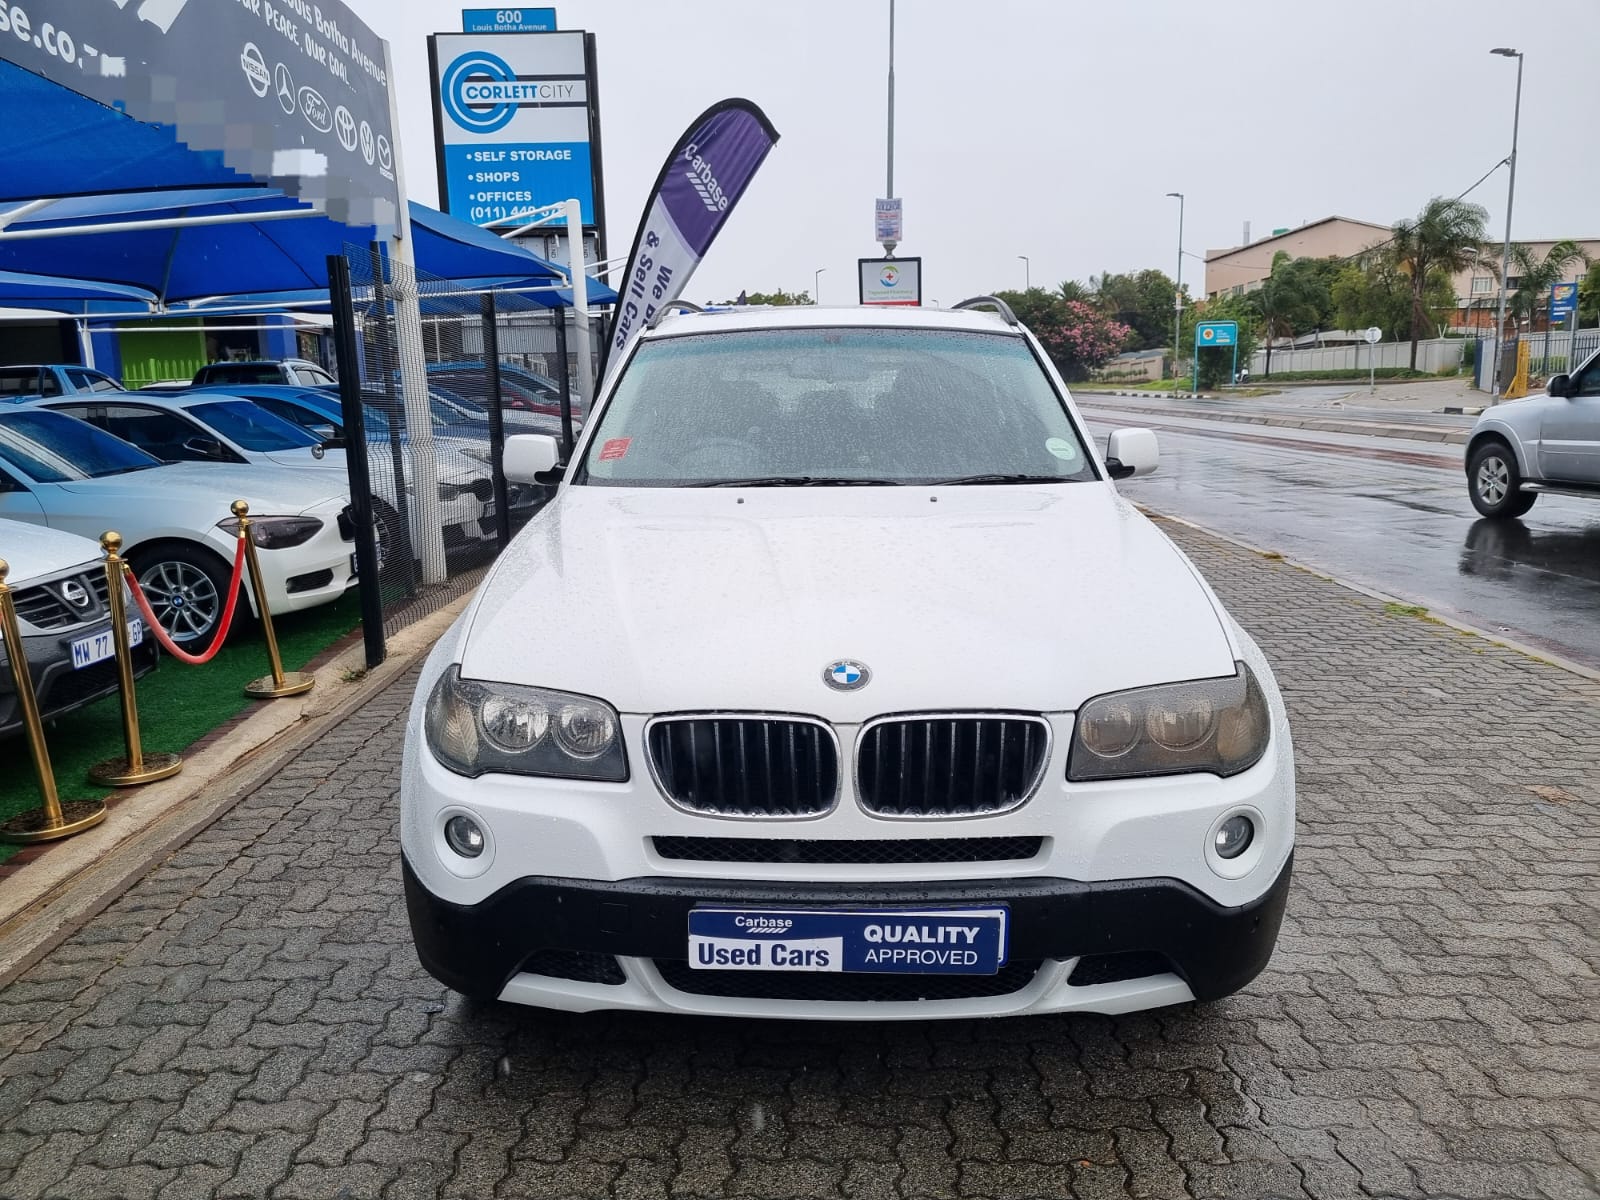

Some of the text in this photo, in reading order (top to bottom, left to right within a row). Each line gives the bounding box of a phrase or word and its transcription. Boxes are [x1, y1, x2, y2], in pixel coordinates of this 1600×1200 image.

[496, 10, 522, 24] 600
[472, 23, 547, 32] Louis Botha Avenue
[304, 32, 327, 67] OUR
[314, 5, 350, 56] Botha
[351, 38, 387, 87] Avenue
[474, 149, 572, 162] SELF STORAGE
[475, 171, 520, 183] SHOPS
[684, 143, 728, 211] Carbase
[477, 191, 532, 202] OFFICES
[470, 206, 506, 221] (011)
[646, 230, 660, 248] &
[631, 254, 653, 299] Sell
[652, 265, 673, 300] We
[616, 301, 638, 350] Cars
[74, 641, 91, 665] MW
[132, 621, 142, 643] GP
[735, 915, 793, 928] Carbase
[864, 924, 980, 944] QUALITY
[698, 942, 830, 967] Used Cars
[864, 949, 978, 965] APPROVED
